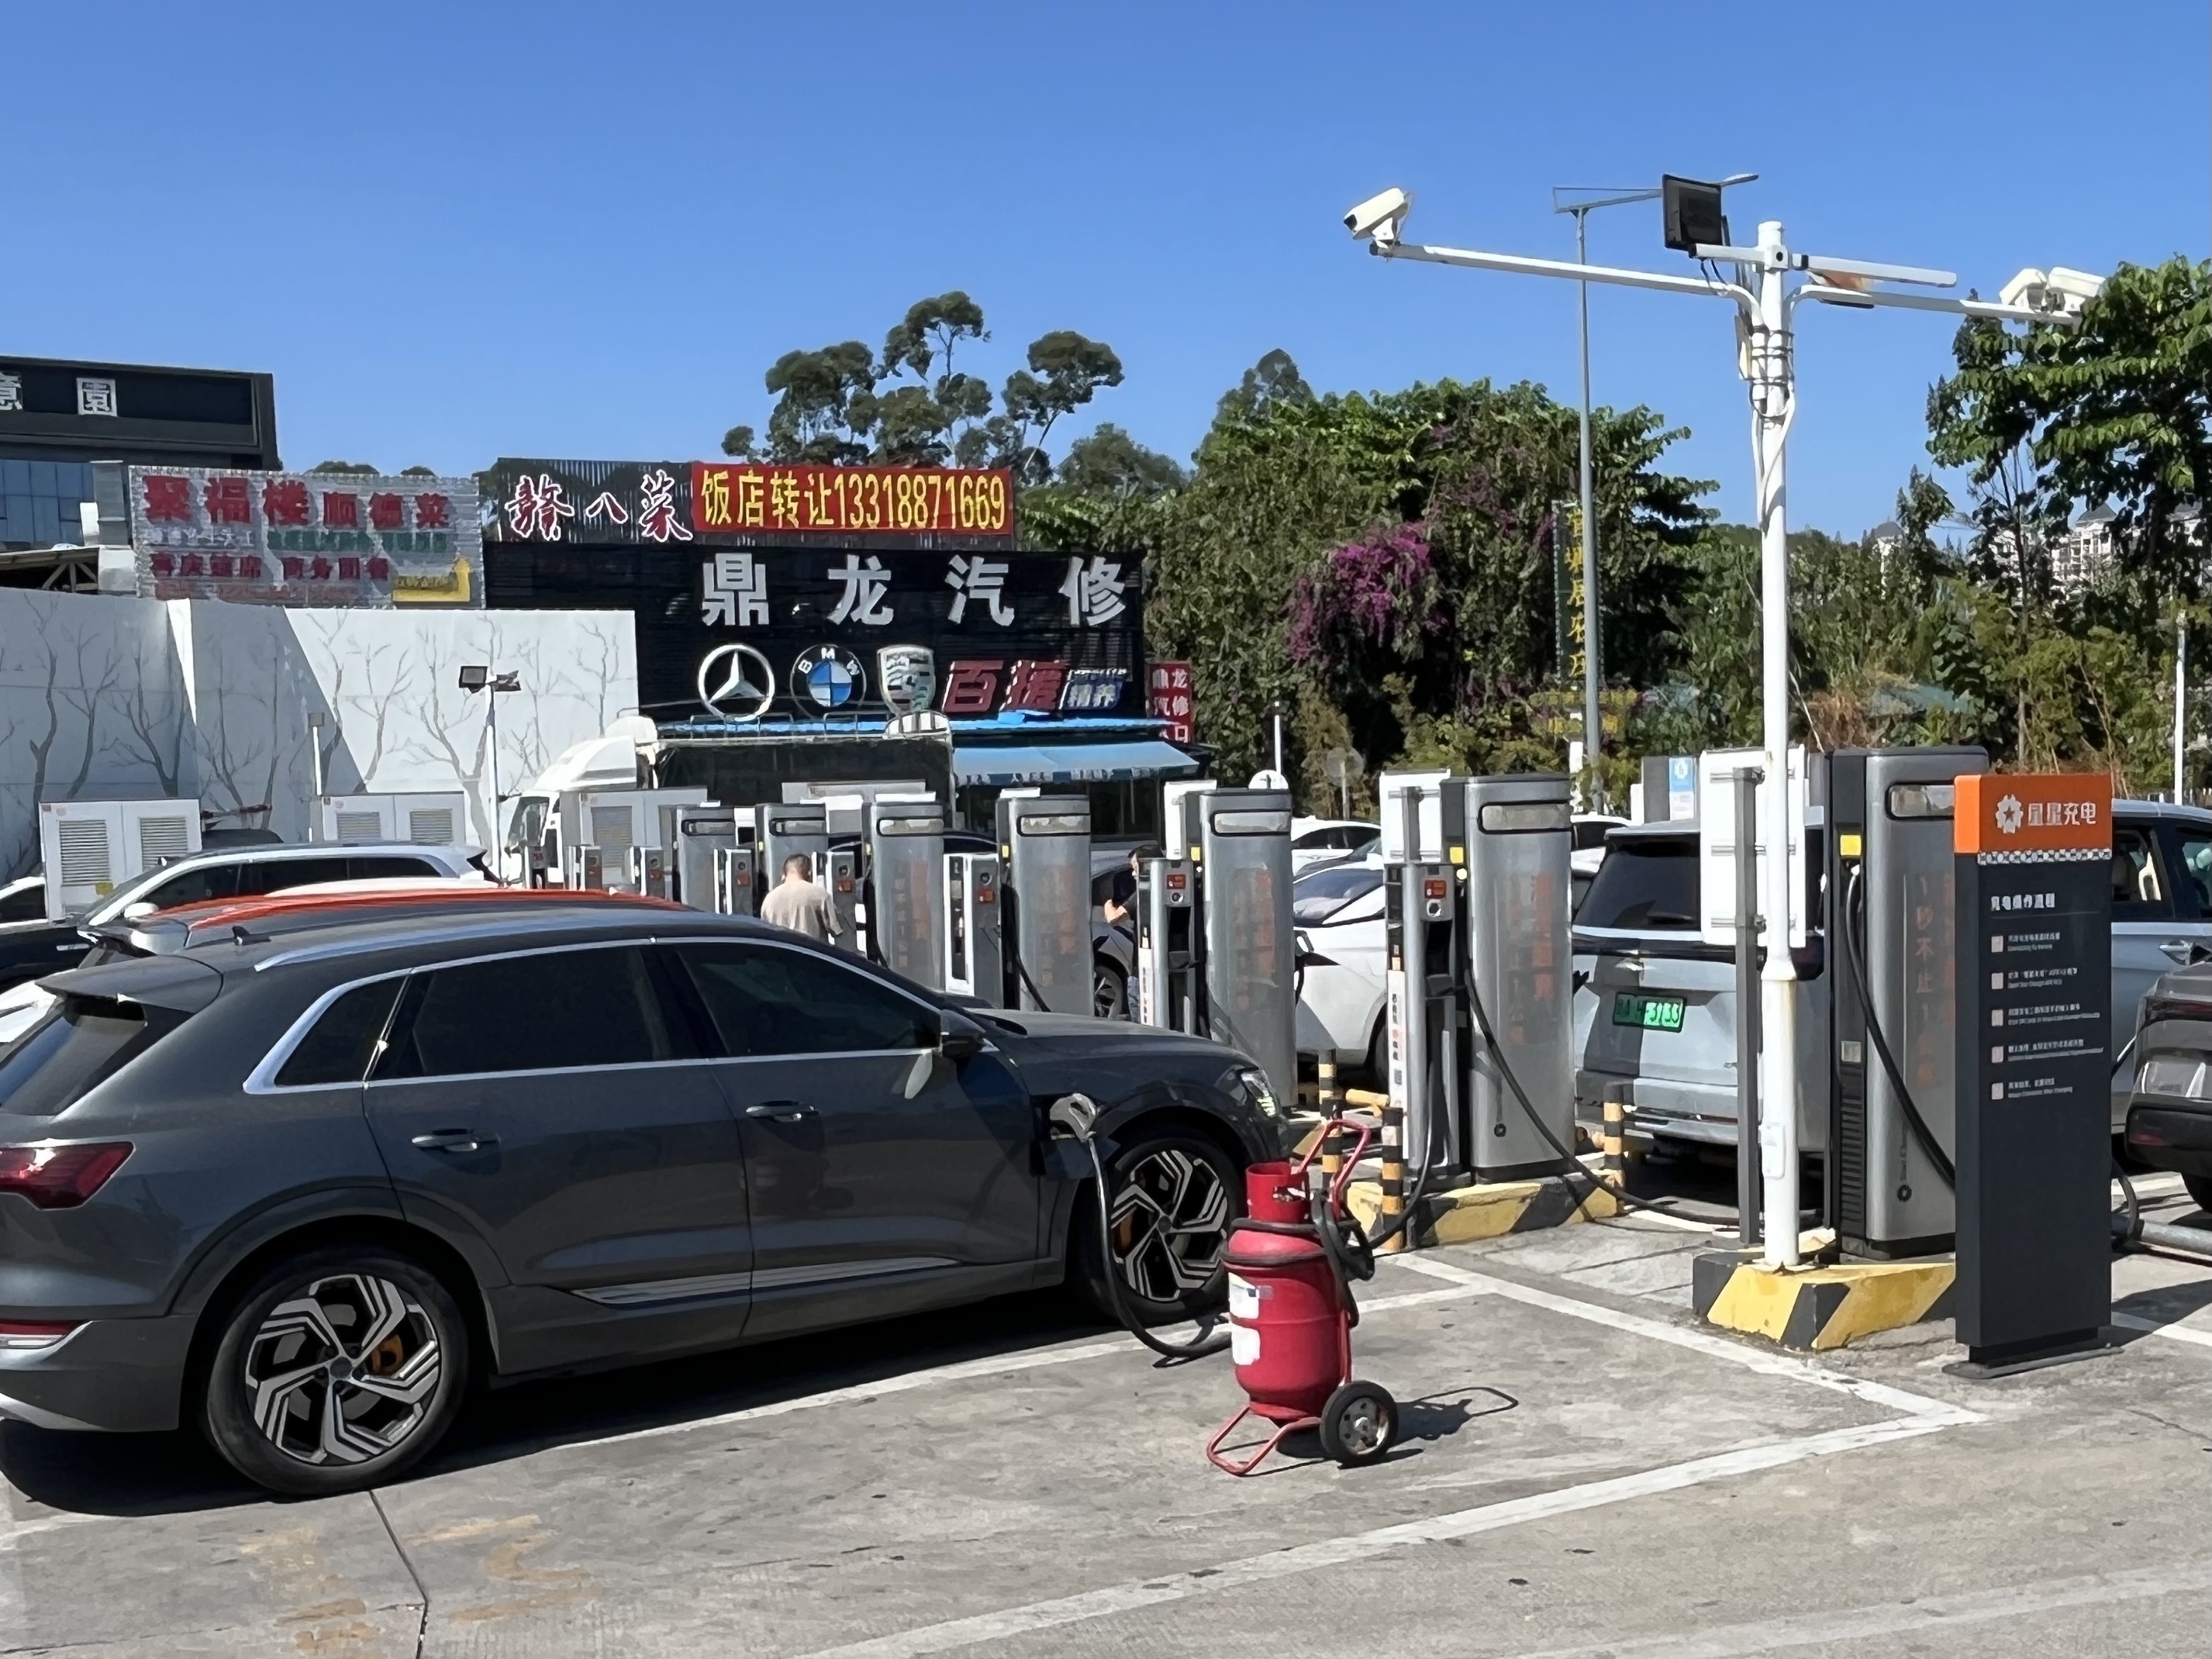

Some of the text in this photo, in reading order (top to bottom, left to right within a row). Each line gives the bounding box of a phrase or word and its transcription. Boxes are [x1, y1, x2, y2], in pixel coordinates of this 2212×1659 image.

[702, 468, 1006, 529] 饭店转让13318871669
[702, 553, 1127, 626] 鼎龙汽修
